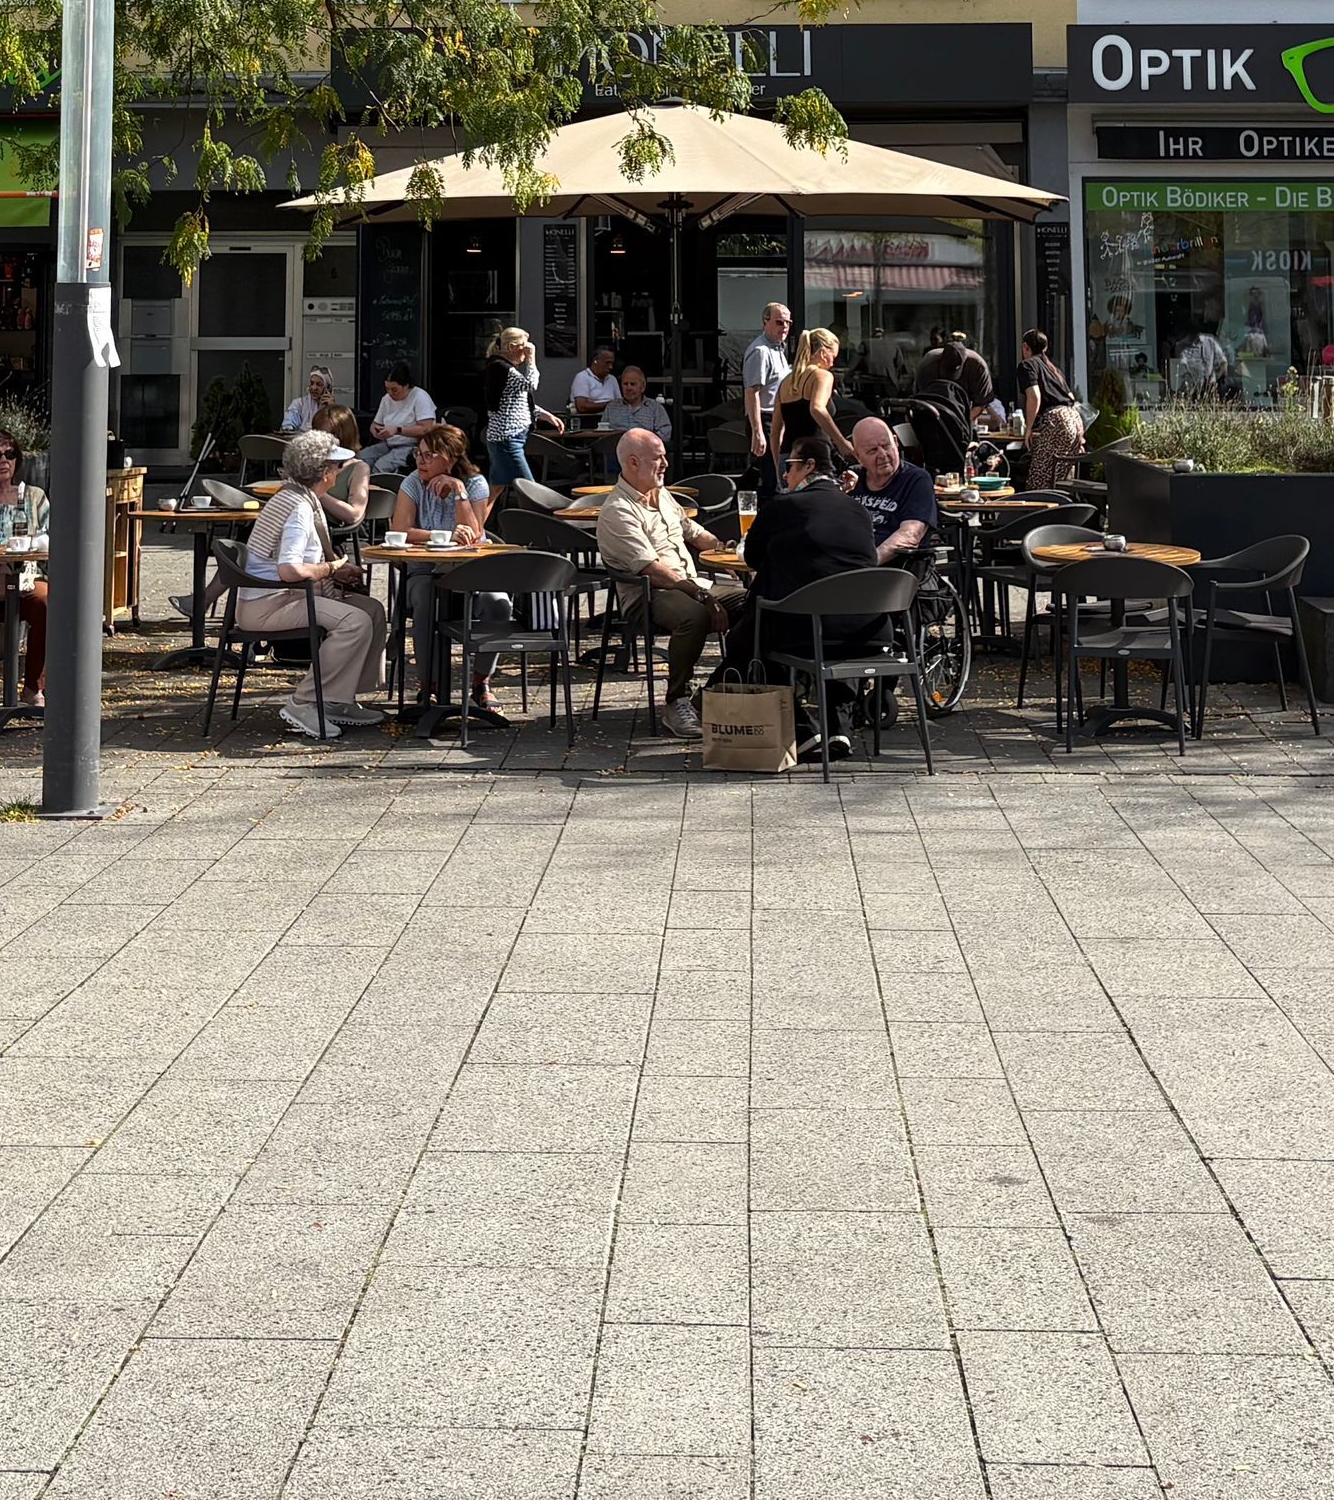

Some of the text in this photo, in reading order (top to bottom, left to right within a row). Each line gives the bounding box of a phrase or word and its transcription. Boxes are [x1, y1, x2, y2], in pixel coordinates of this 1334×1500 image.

[1092, 34, 1257, 91] OPTIK
[1158, 130, 1204, 157] IHR
[1101, 186, 1159, 208] OPTIK
[1166, 186, 1250, 208] BÖDIKER
[1275, 186, 1309, 208] DIE
